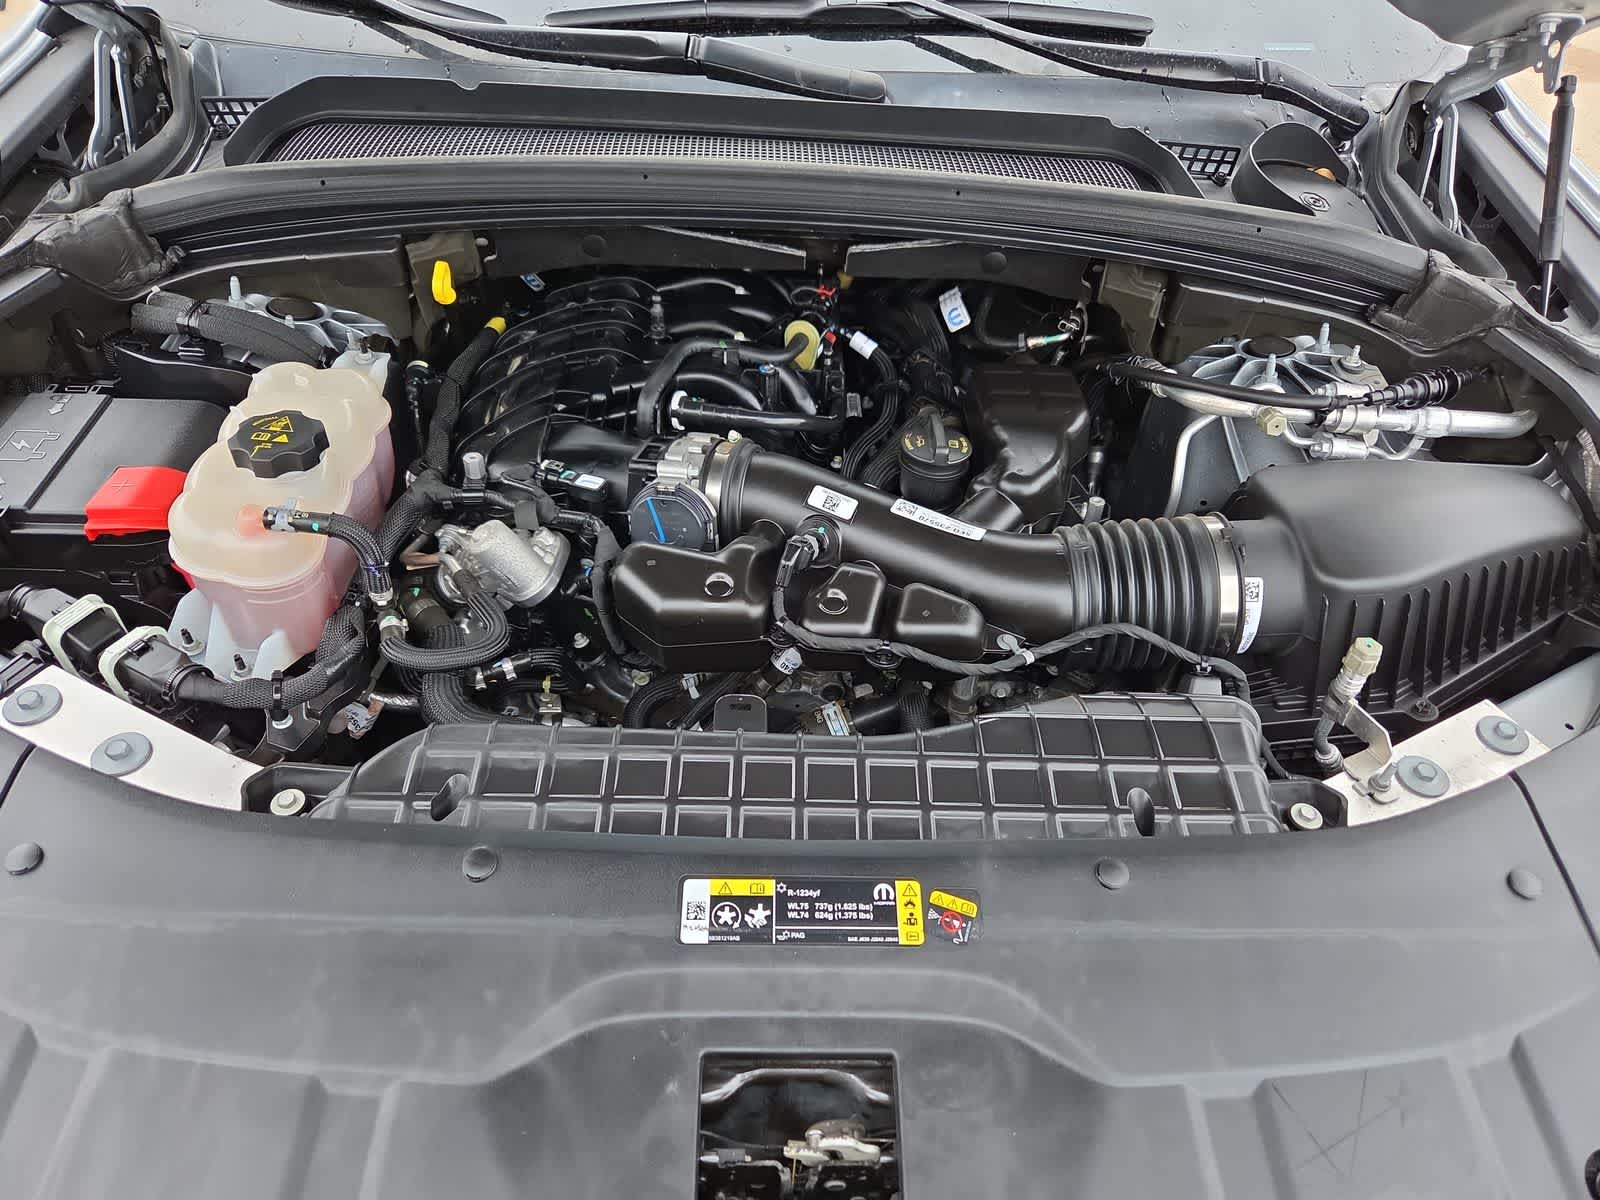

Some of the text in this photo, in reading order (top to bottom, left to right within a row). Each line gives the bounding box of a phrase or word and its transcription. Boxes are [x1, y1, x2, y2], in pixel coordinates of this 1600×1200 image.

[787, 889, 821, 898] R-1234yf
[787, 902, 809, 910] WL75
[814, 902, 833, 912] 737g
[858, 902, 874, 911] lbs)
[787, 911, 809, 919] WL74
[814, 911, 833, 920] 624g
[858, 911, 874, 920] lbs)
[790, 931, 806, 939] PAG
